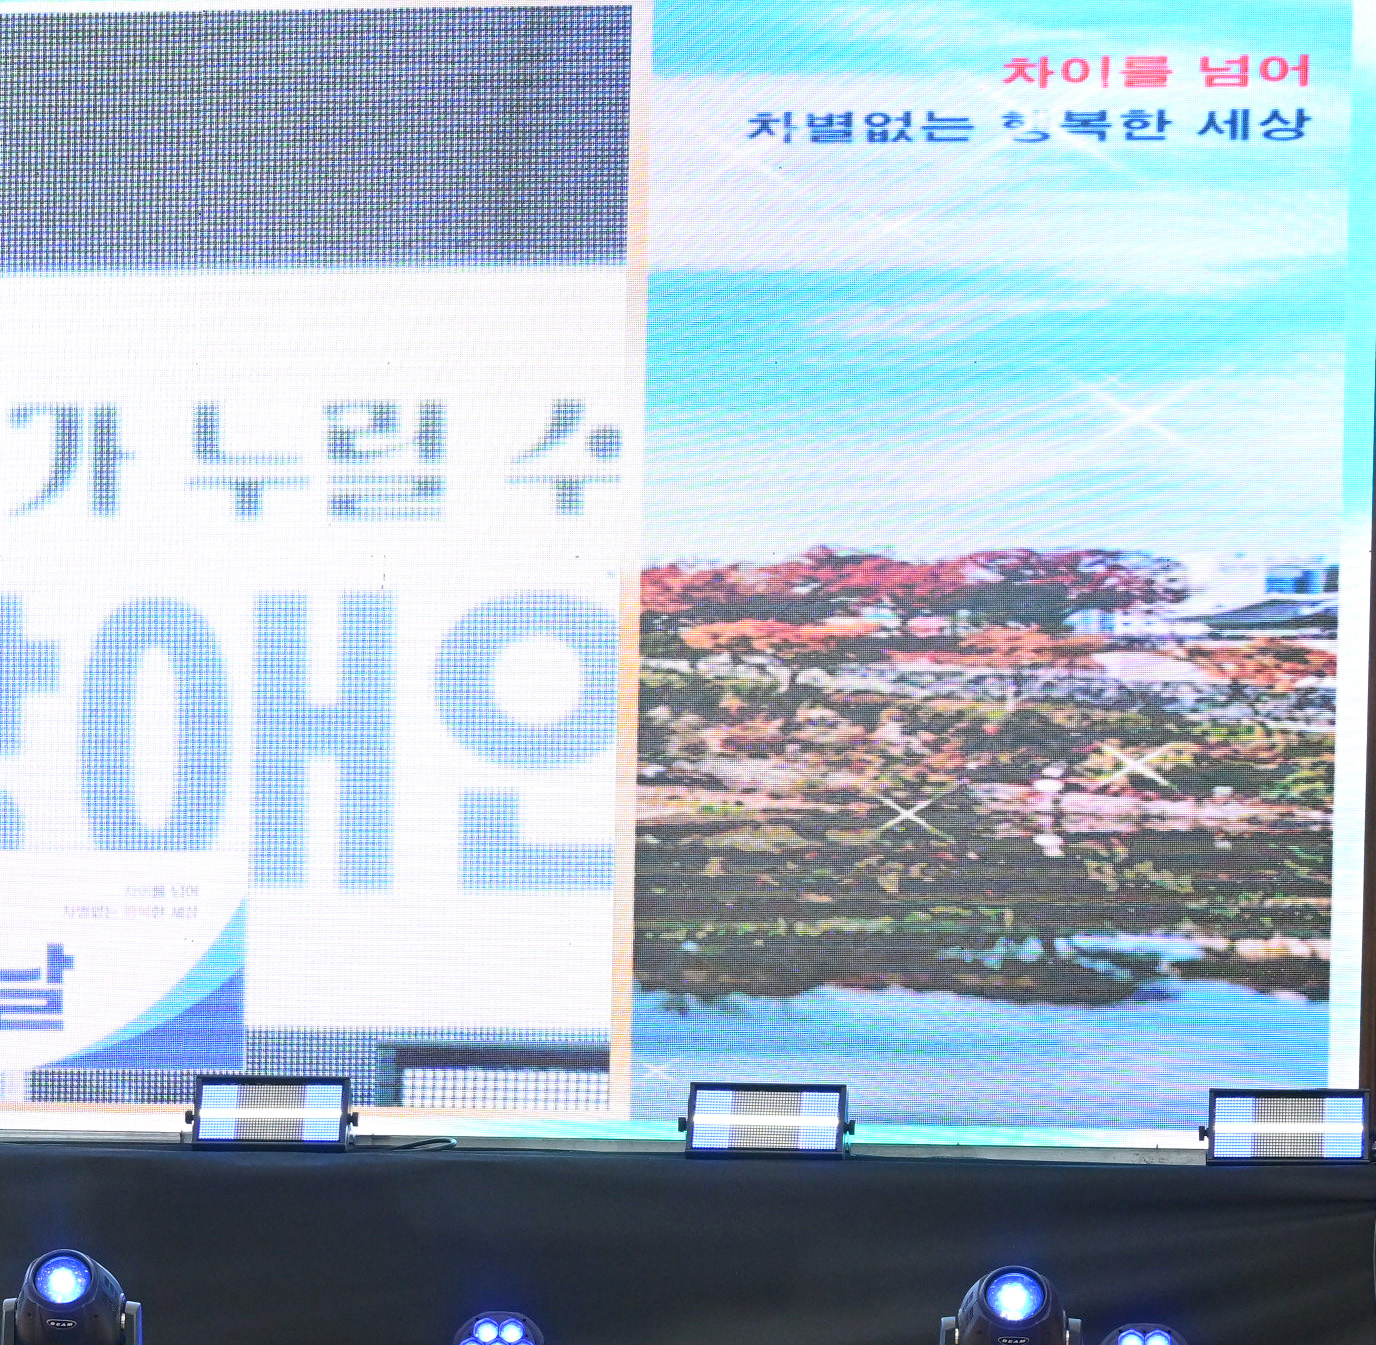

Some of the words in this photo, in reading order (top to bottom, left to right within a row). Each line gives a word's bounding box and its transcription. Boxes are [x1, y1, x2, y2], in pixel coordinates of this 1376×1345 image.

[1003, 55, 1171, 88] 차이를
[1200, 53, 1310, 88] 넘어
[747, 109, 975, 145] 차별없는
[1197, 108, 1312, 142] 세상
[184, 400, 446, 521] 누릴
[504, 397, 624, 517] 수
